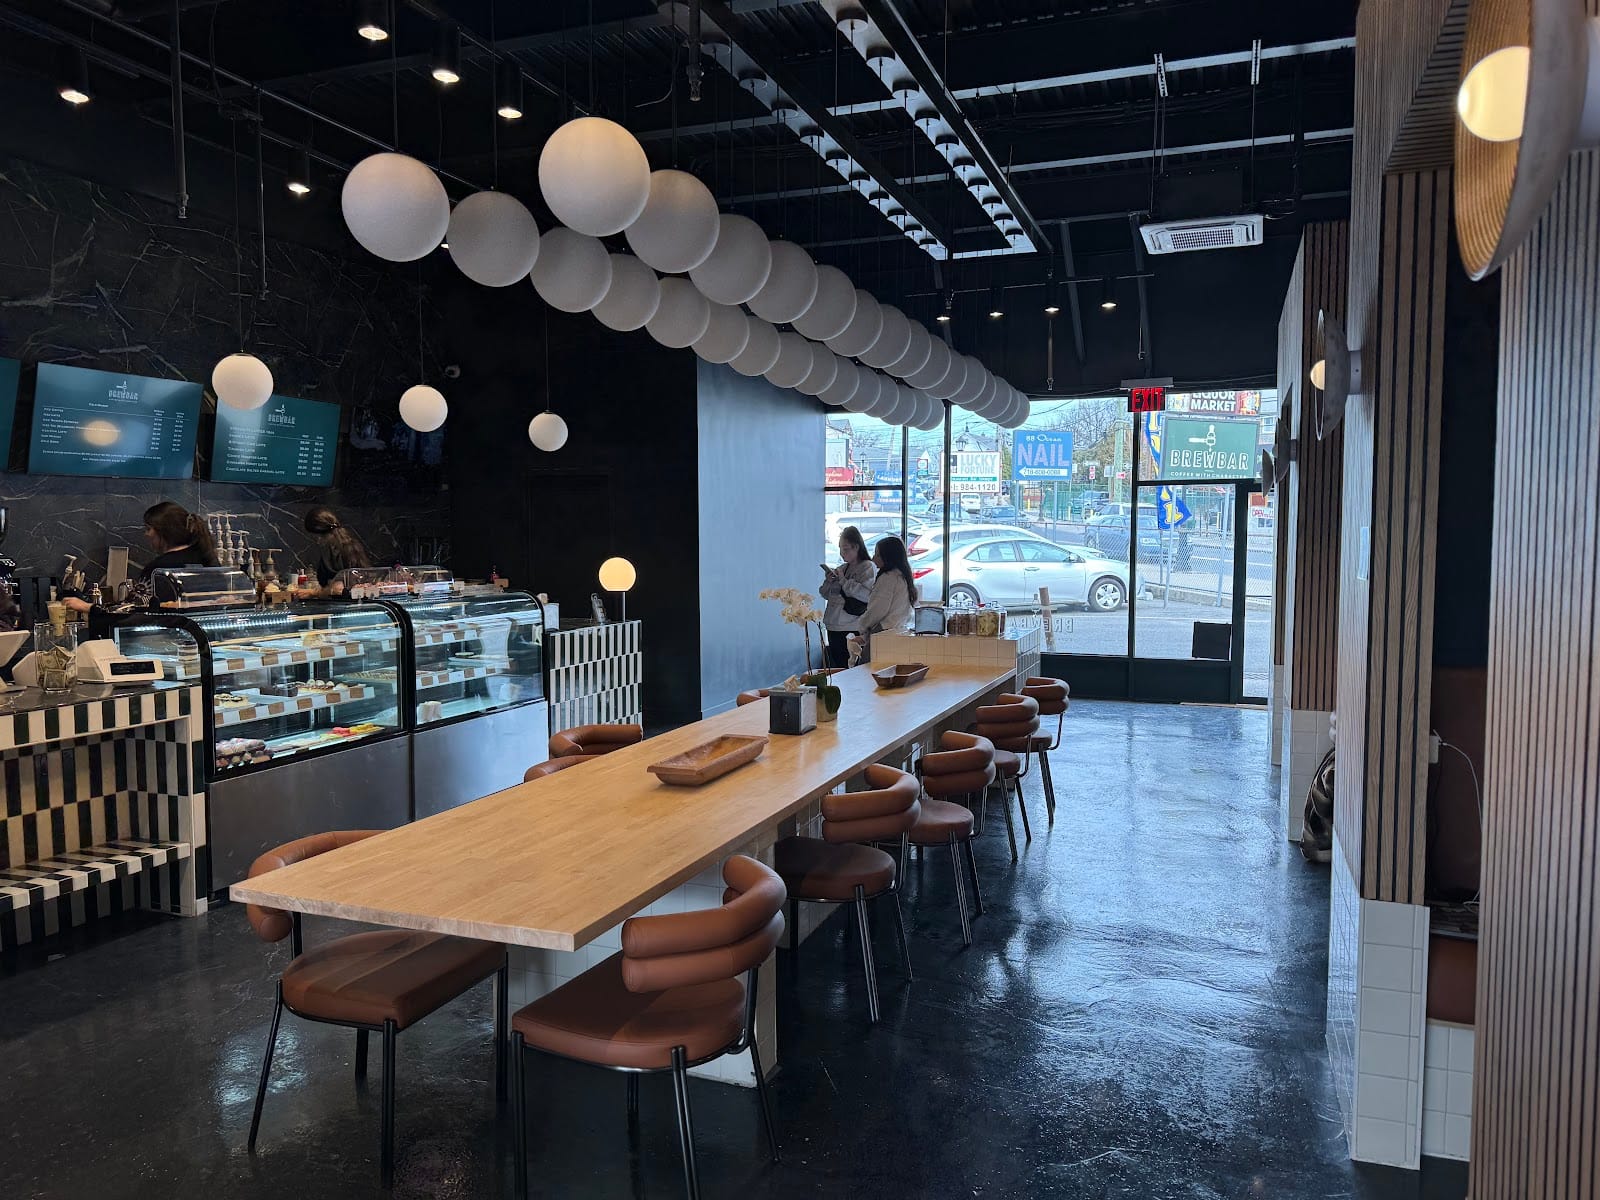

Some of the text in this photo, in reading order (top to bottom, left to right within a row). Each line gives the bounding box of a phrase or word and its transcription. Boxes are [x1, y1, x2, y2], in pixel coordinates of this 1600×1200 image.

[1132, 388, 1164, 412] EXIT
[1192, 391, 1236, 400] LIQUOR
[1190, 399, 1237, 412] MARKET
[960, 454, 997, 466] LUCKY
[1017, 443, 1070, 467] NAIL
[1170, 449, 1249, 470] BREWBAR
[960, 465, 996, 475] FORTUNE
